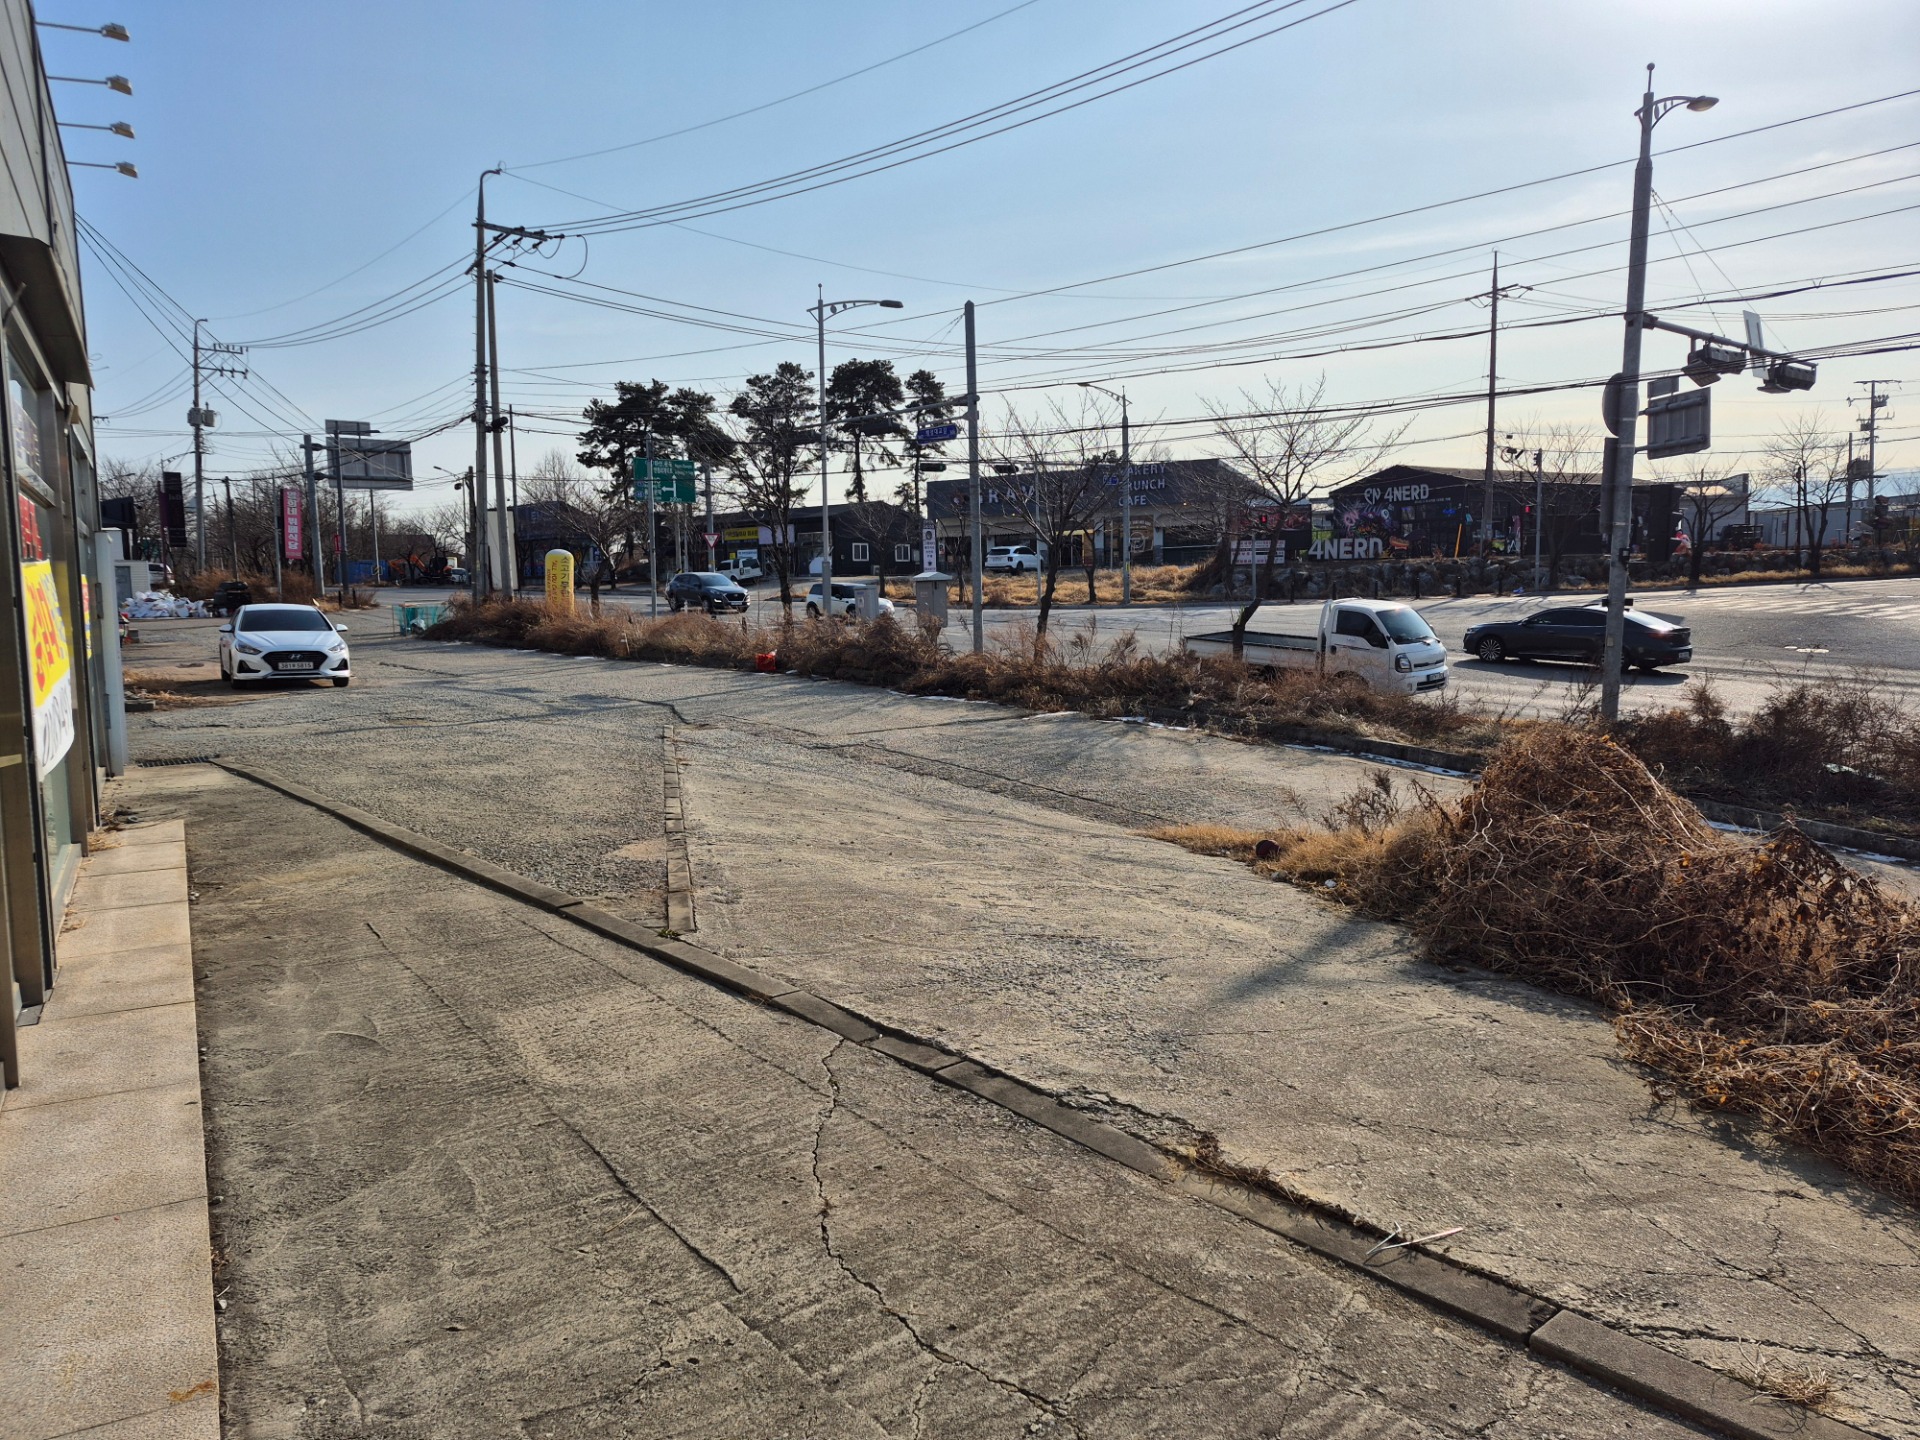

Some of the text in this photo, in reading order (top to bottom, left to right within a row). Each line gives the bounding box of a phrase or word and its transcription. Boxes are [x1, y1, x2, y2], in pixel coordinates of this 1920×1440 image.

[1120, 464, 1166, 475] AKERY
[1119, 479, 1165, 491] RUNCH
[1384, 484, 1430, 502] 4NERD
[1308, 537, 1384, 560] 4NERD
